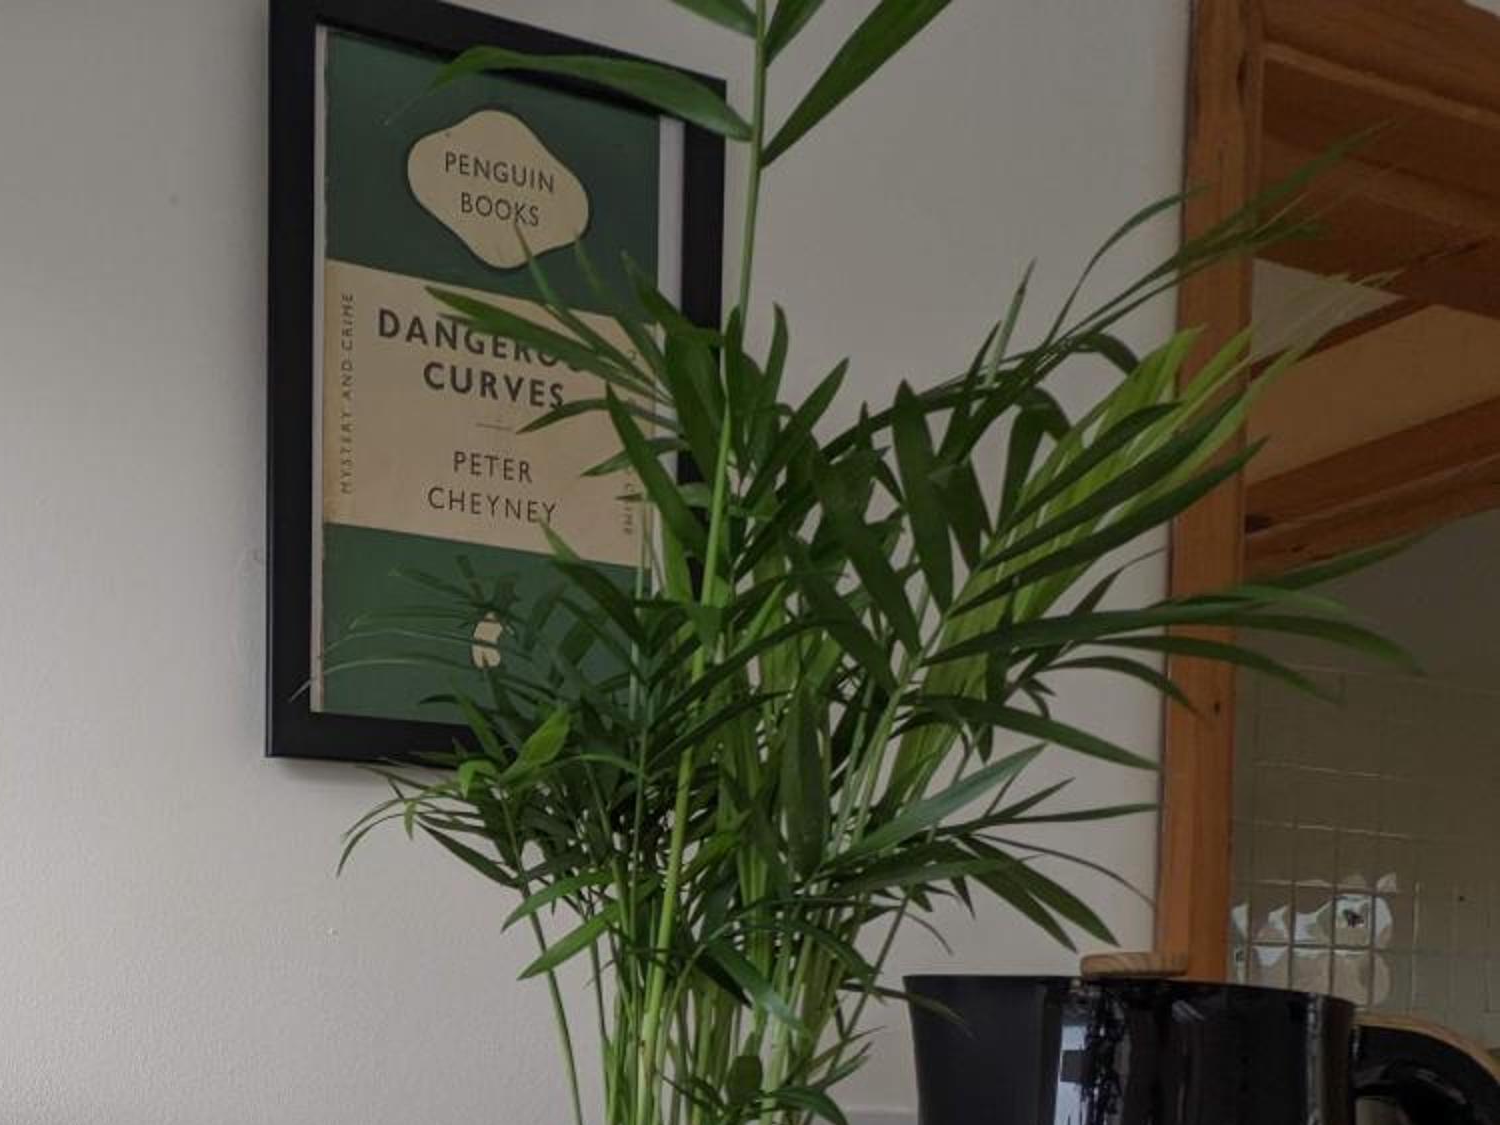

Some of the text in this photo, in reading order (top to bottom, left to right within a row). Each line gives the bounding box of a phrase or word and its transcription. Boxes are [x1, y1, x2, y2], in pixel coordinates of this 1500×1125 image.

[445, 151, 554, 193] PENGUIN
[461, 192, 539, 226] BOOKS
[378, 308, 582, 373] DANGER
[340, 293, 353, 494] MYSTERY AND CRIME
[423, 361, 564, 409] CURVES
[453, 451, 532, 483] PETER
[428, 487, 555, 522] CHEYNEY
